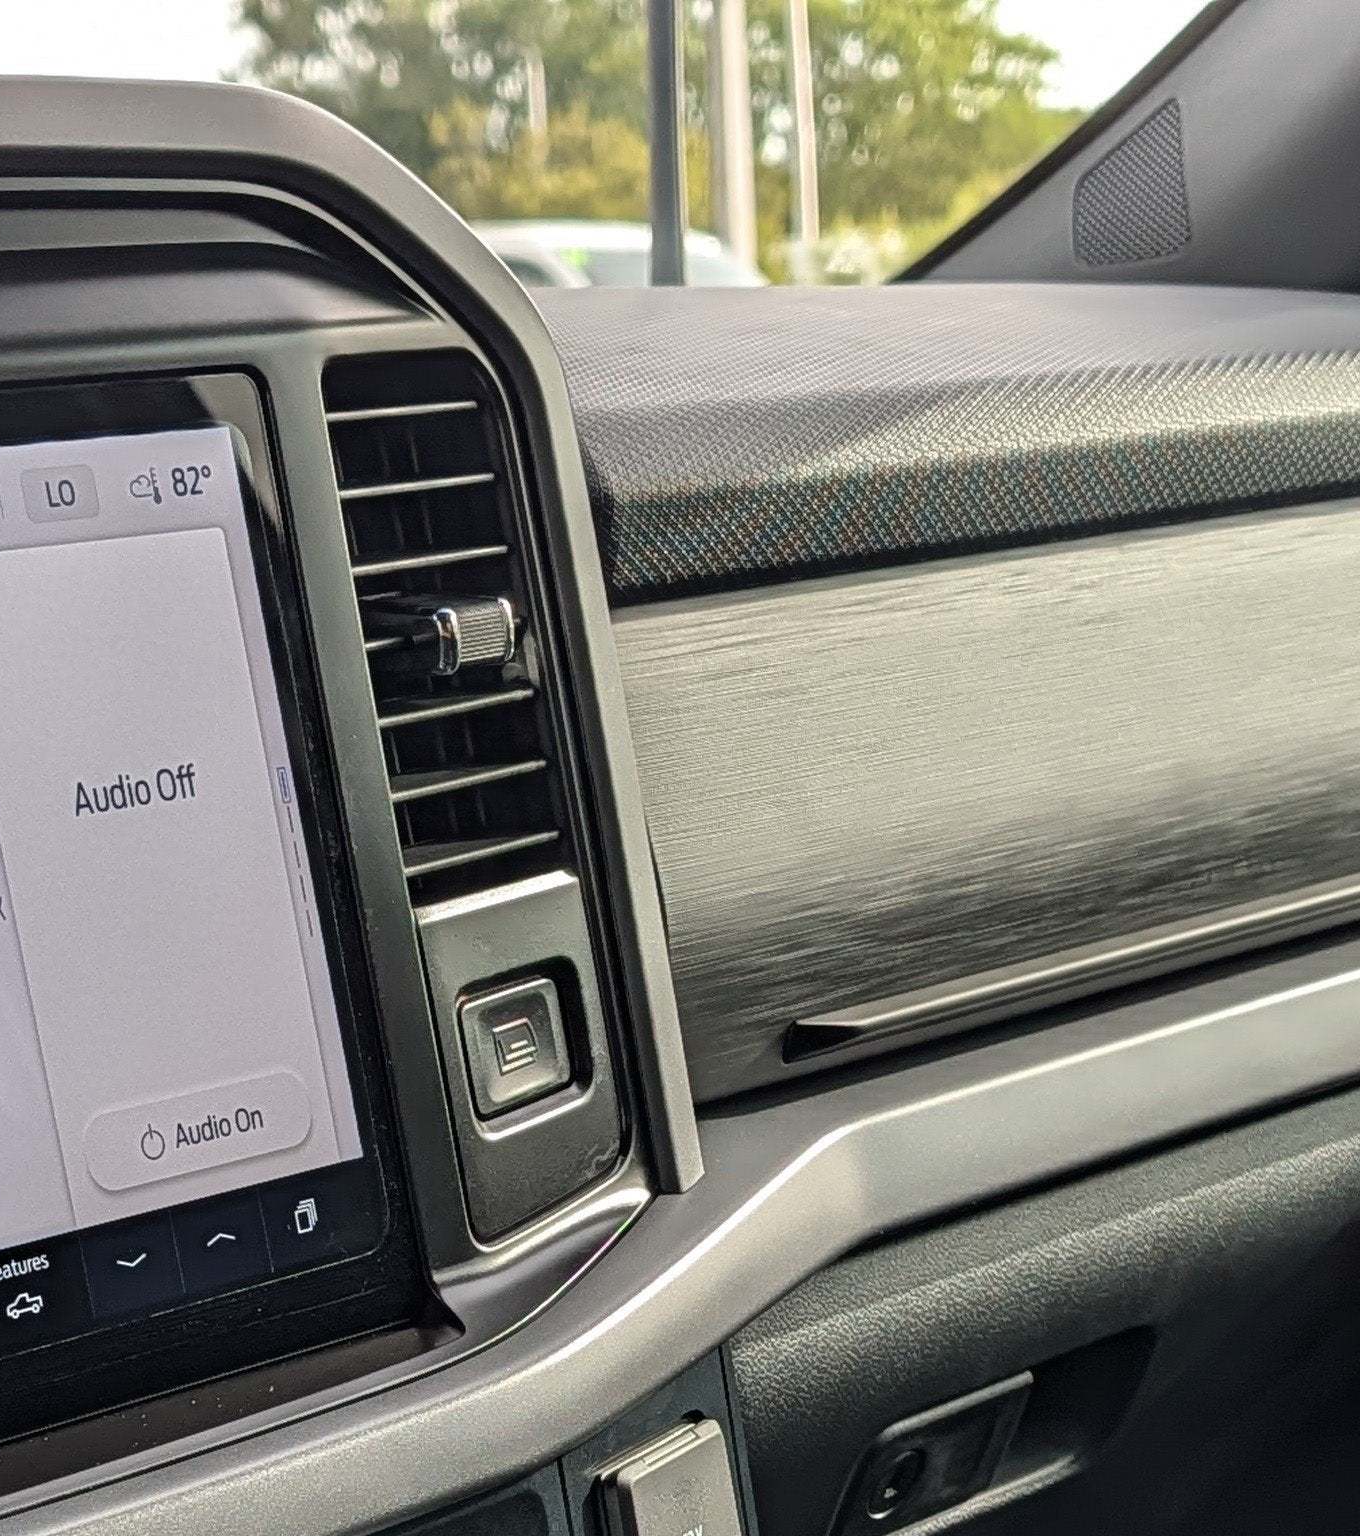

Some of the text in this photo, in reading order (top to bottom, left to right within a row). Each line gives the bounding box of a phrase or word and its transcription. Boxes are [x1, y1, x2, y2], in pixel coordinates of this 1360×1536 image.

[45, 480, 75, 507] LO
[75, 763, 196, 816] Audio Off
[175, 1108, 264, 1148] Audio On
